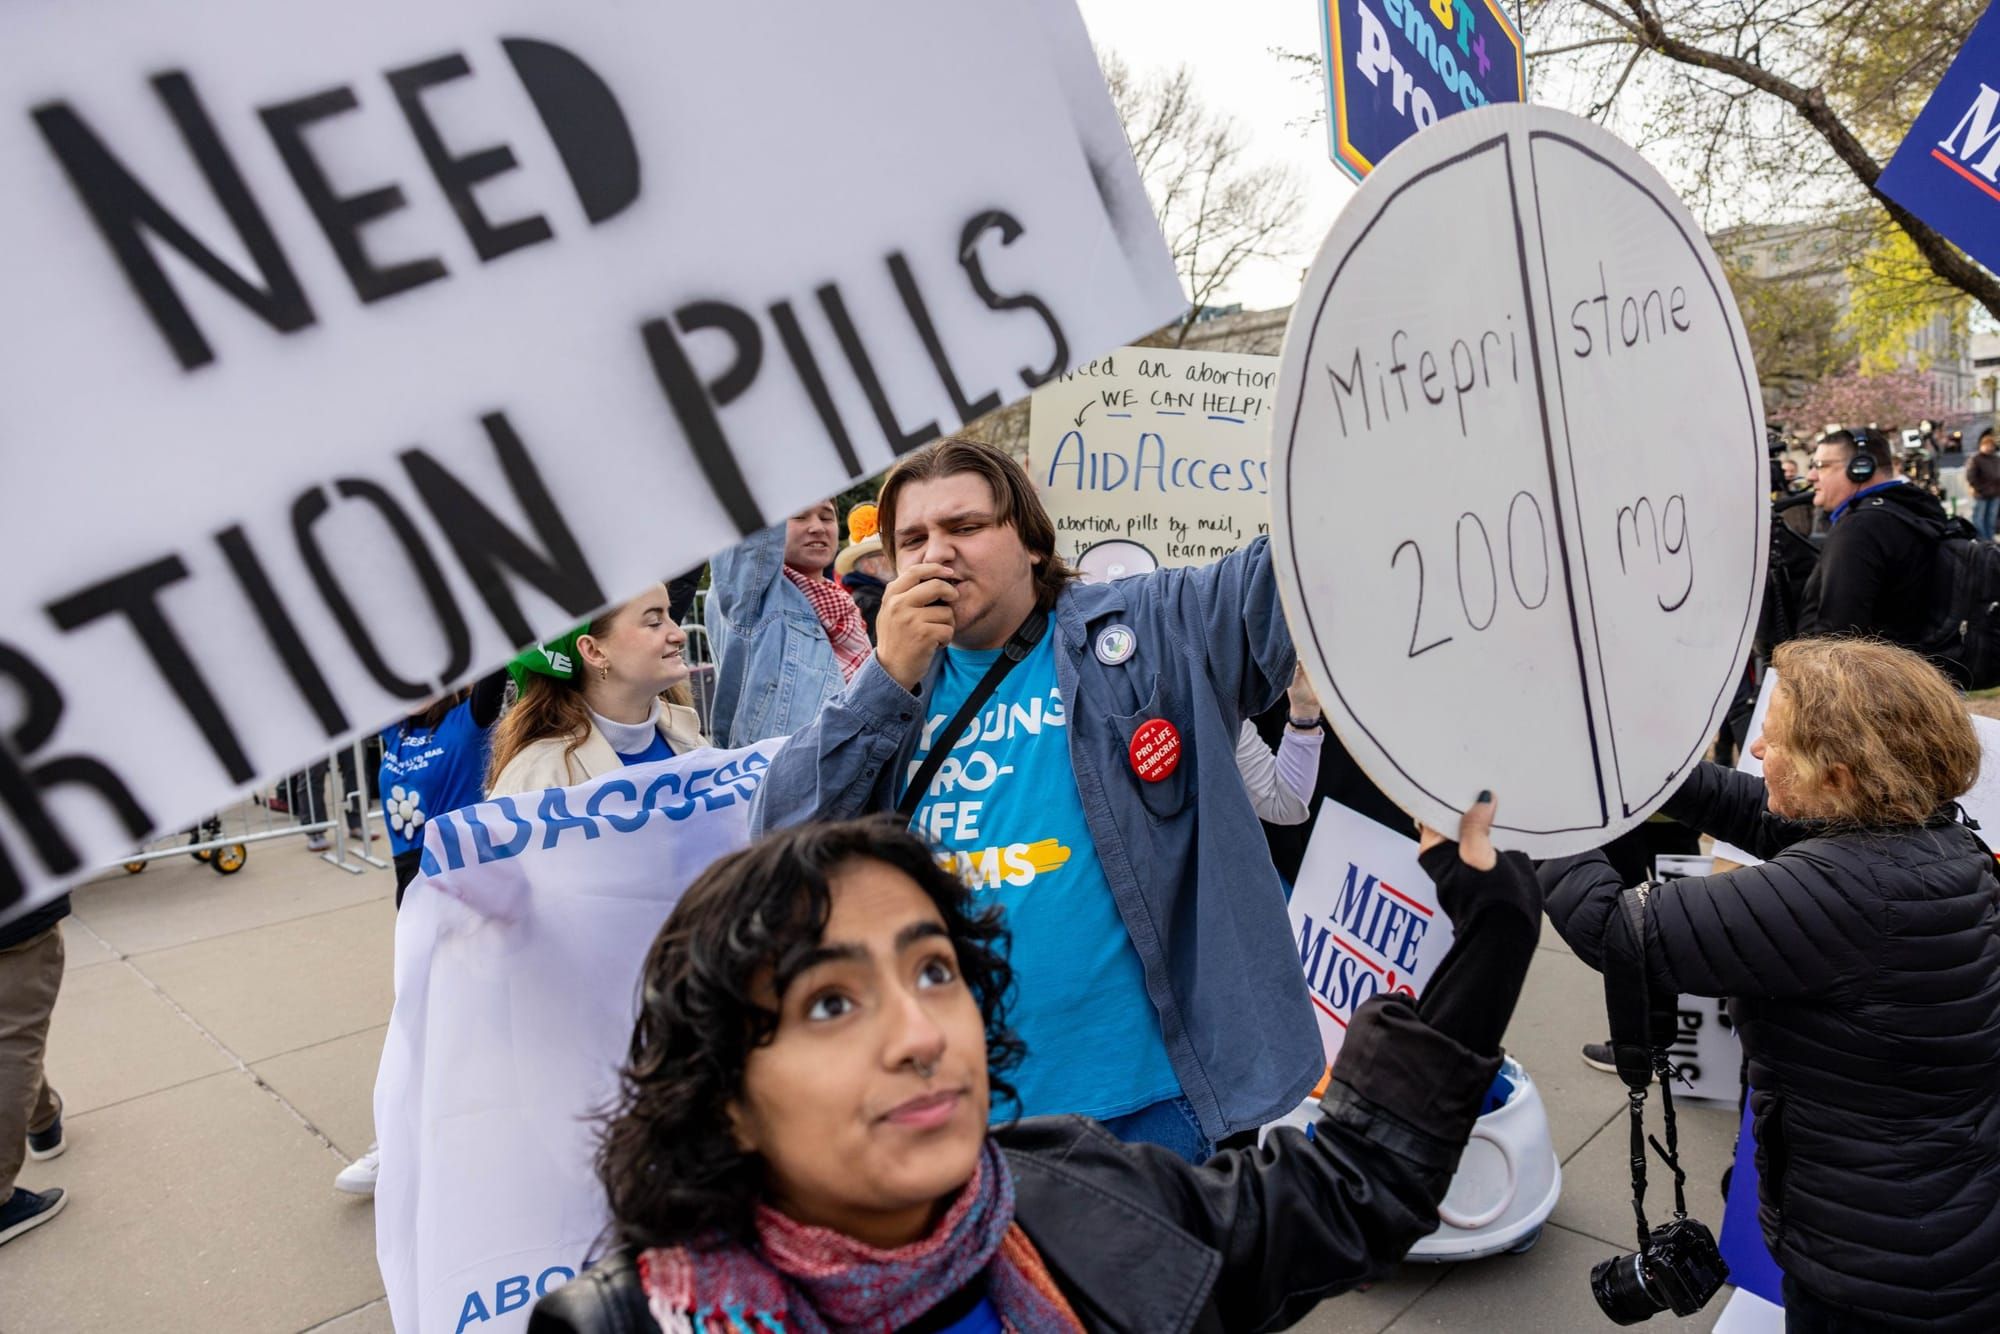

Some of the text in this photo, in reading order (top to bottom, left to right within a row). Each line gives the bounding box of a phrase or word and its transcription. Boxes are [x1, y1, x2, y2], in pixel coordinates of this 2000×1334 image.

[1357, 0, 1439, 131] Pro
[29, 37, 642, 372] NEED
[641, 209, 1070, 538] PILLS
[1138, 359, 1171, 378] an
[1185, 361, 1276, 389] abortion
[1326, 260, 1691, 438] Mifepri stone
[1101, 388, 1263, 421] WE CAN HELP!
[1057, 515, 1121, 533] abortion
[1126, 513, 1158, 537] pills
[1169, 516, 1190, 544] by
[1198, 514, 1241, 540] mail,
[1167, 543, 1206, 558] learn
[1391, 491, 1694, 659] 200 mg
[1136, 726, 1172, 761] PRO-LIFE
[907, 800, 983, 844] IFE
[1329, 862, 1429, 975] MIFE
